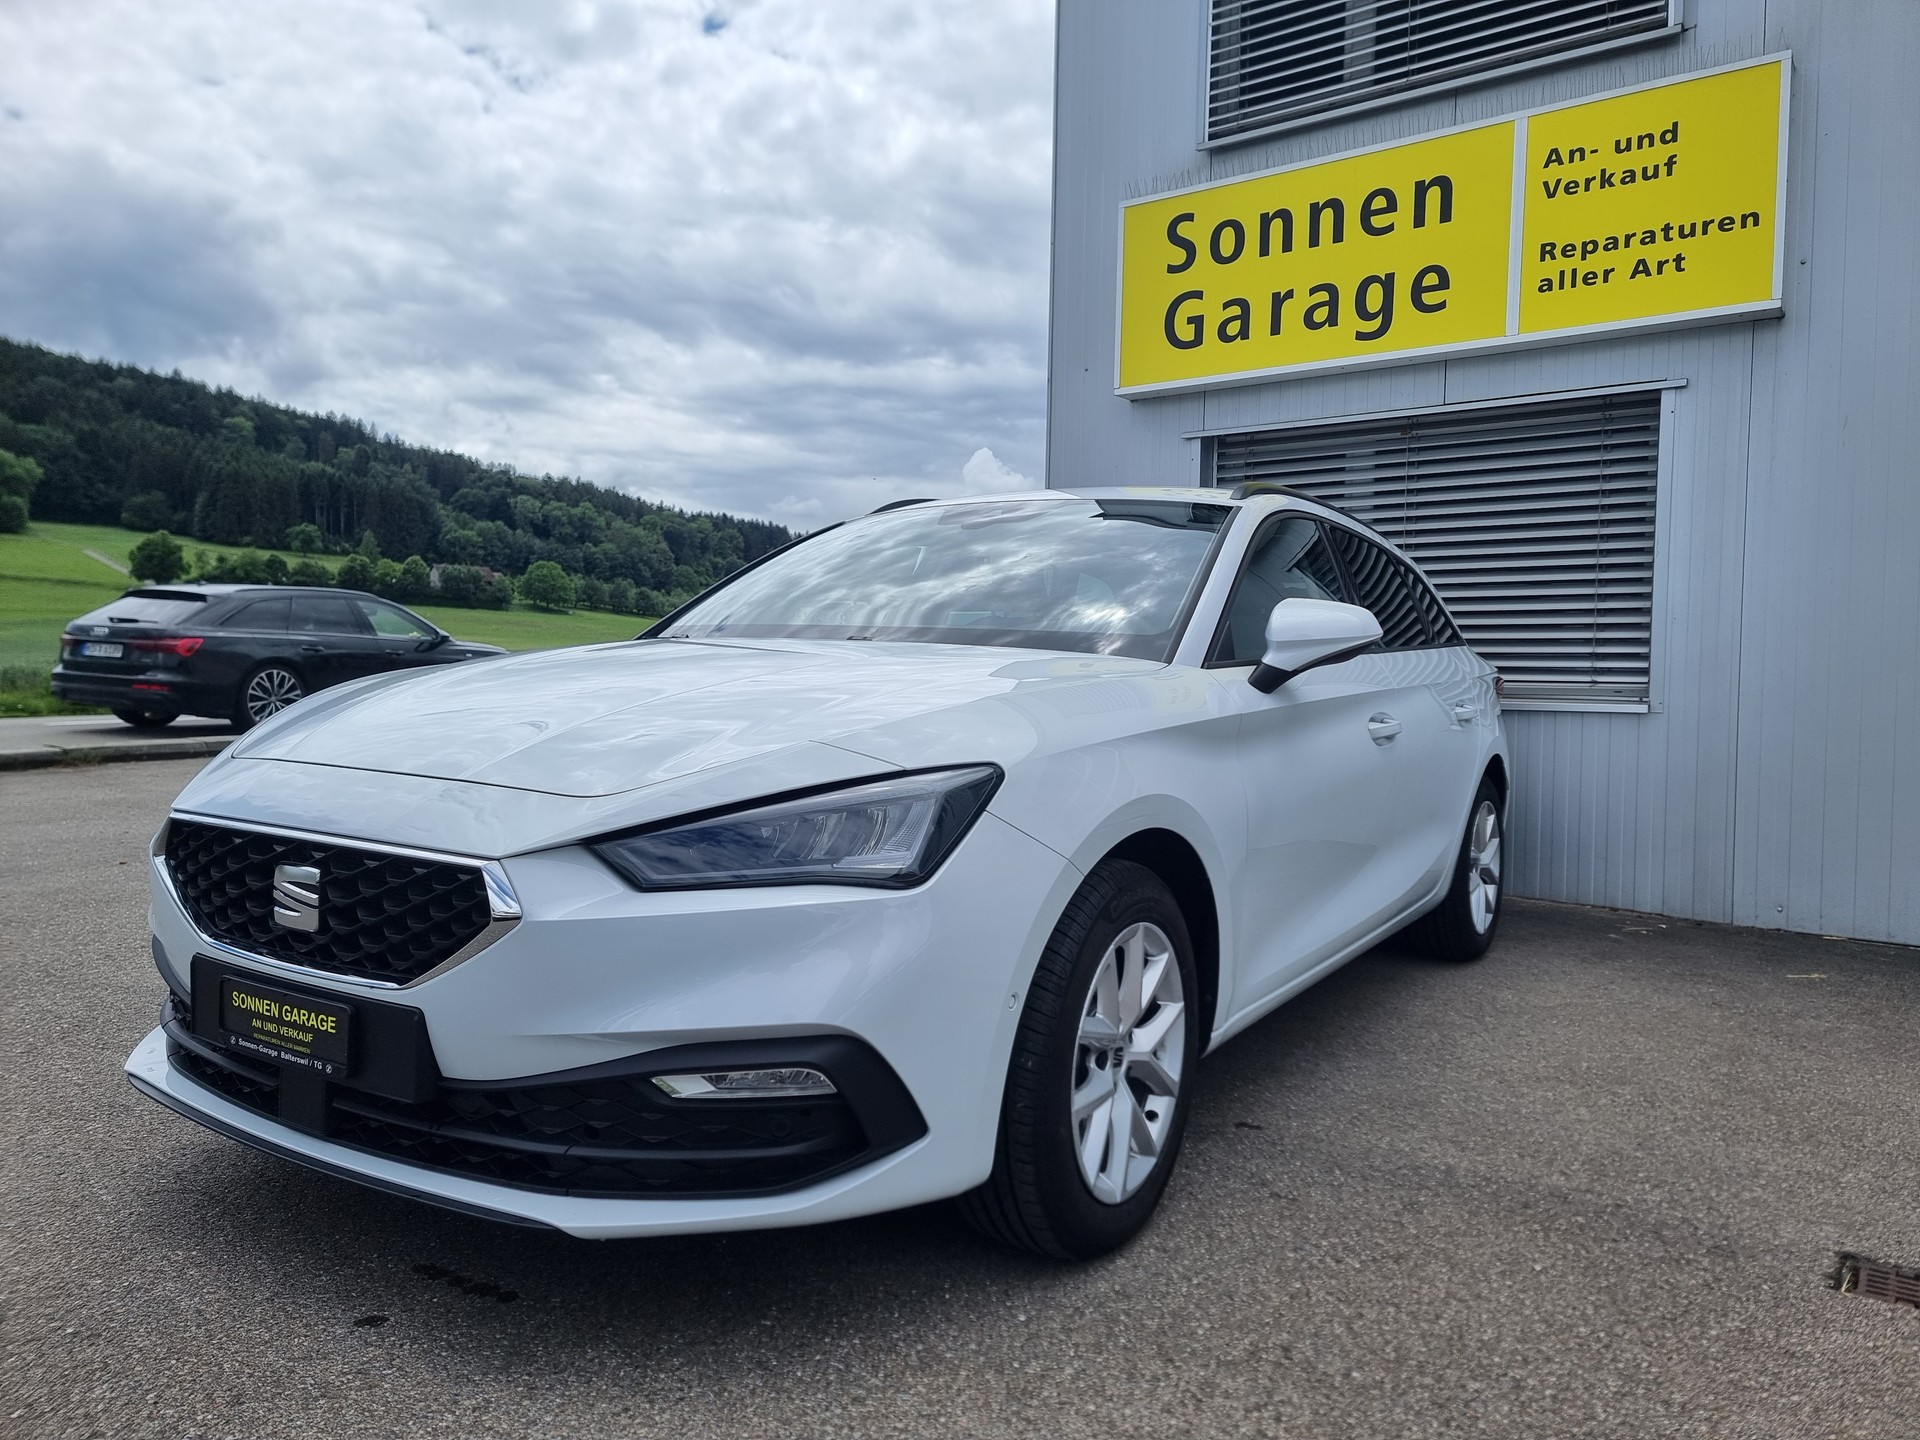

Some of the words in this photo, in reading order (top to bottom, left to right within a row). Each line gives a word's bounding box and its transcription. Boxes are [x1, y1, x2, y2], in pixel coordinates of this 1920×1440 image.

[1542, 147, 1600, 169] An-
[1614, 120, 1679, 156] und
[1542, 153, 1679, 200] Verkauf
[1165, 173, 1455, 275] Sonnen
[1538, 211, 1761, 263] Reparaturen
[1537, 266, 1617, 294] aller
[1628, 252, 1688, 280] Art
[1163, 264, 1452, 350] Garage
[232, 991, 279, 1018] SONNEN
[282, 1005, 336, 1033] GARAGE
[251, 1018, 262, 1029] AN
[263, 1021, 278, 1033] UND
[279, 1025, 313, 1043] VERKAUF
[238, 1038, 278, 1057] Sonnen-Garage
[280, 1051, 309, 1066] Balterswil
[313, 1060, 322, 1070] TG
